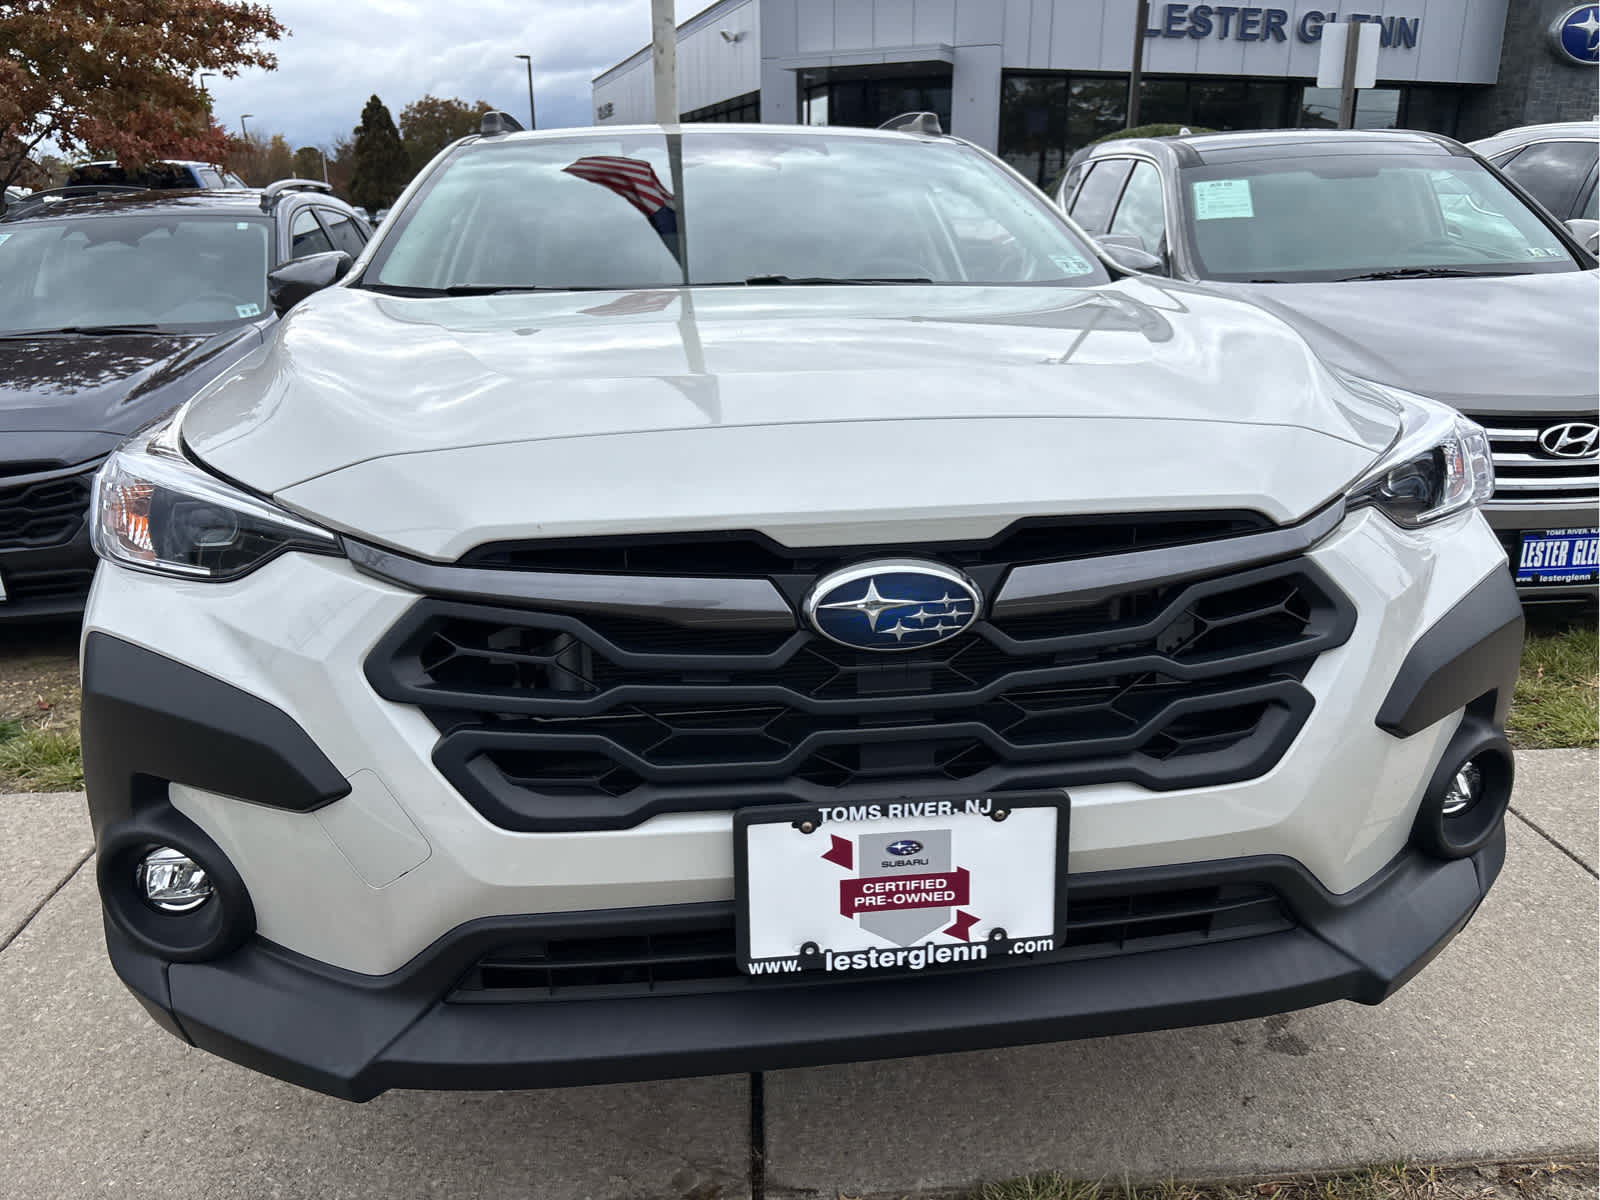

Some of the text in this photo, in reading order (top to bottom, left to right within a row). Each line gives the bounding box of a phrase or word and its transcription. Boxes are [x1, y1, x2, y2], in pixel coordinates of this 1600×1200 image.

[1143, 3, 1288, 42] LESTER
[1520, 542, 1569, 568] LESTER
[1539, 574, 1591, 583] lesterglenn
[818, 804, 881, 823] TOMS
[965, 798, 992, 814] NJ
[881, 859, 928, 868] SUBARU
[862, 878, 947, 894] CERTIFIED
[854, 890, 956, 908] PRE-OWNED
[748, 936, 1055, 975] www. lesterglenn .com
